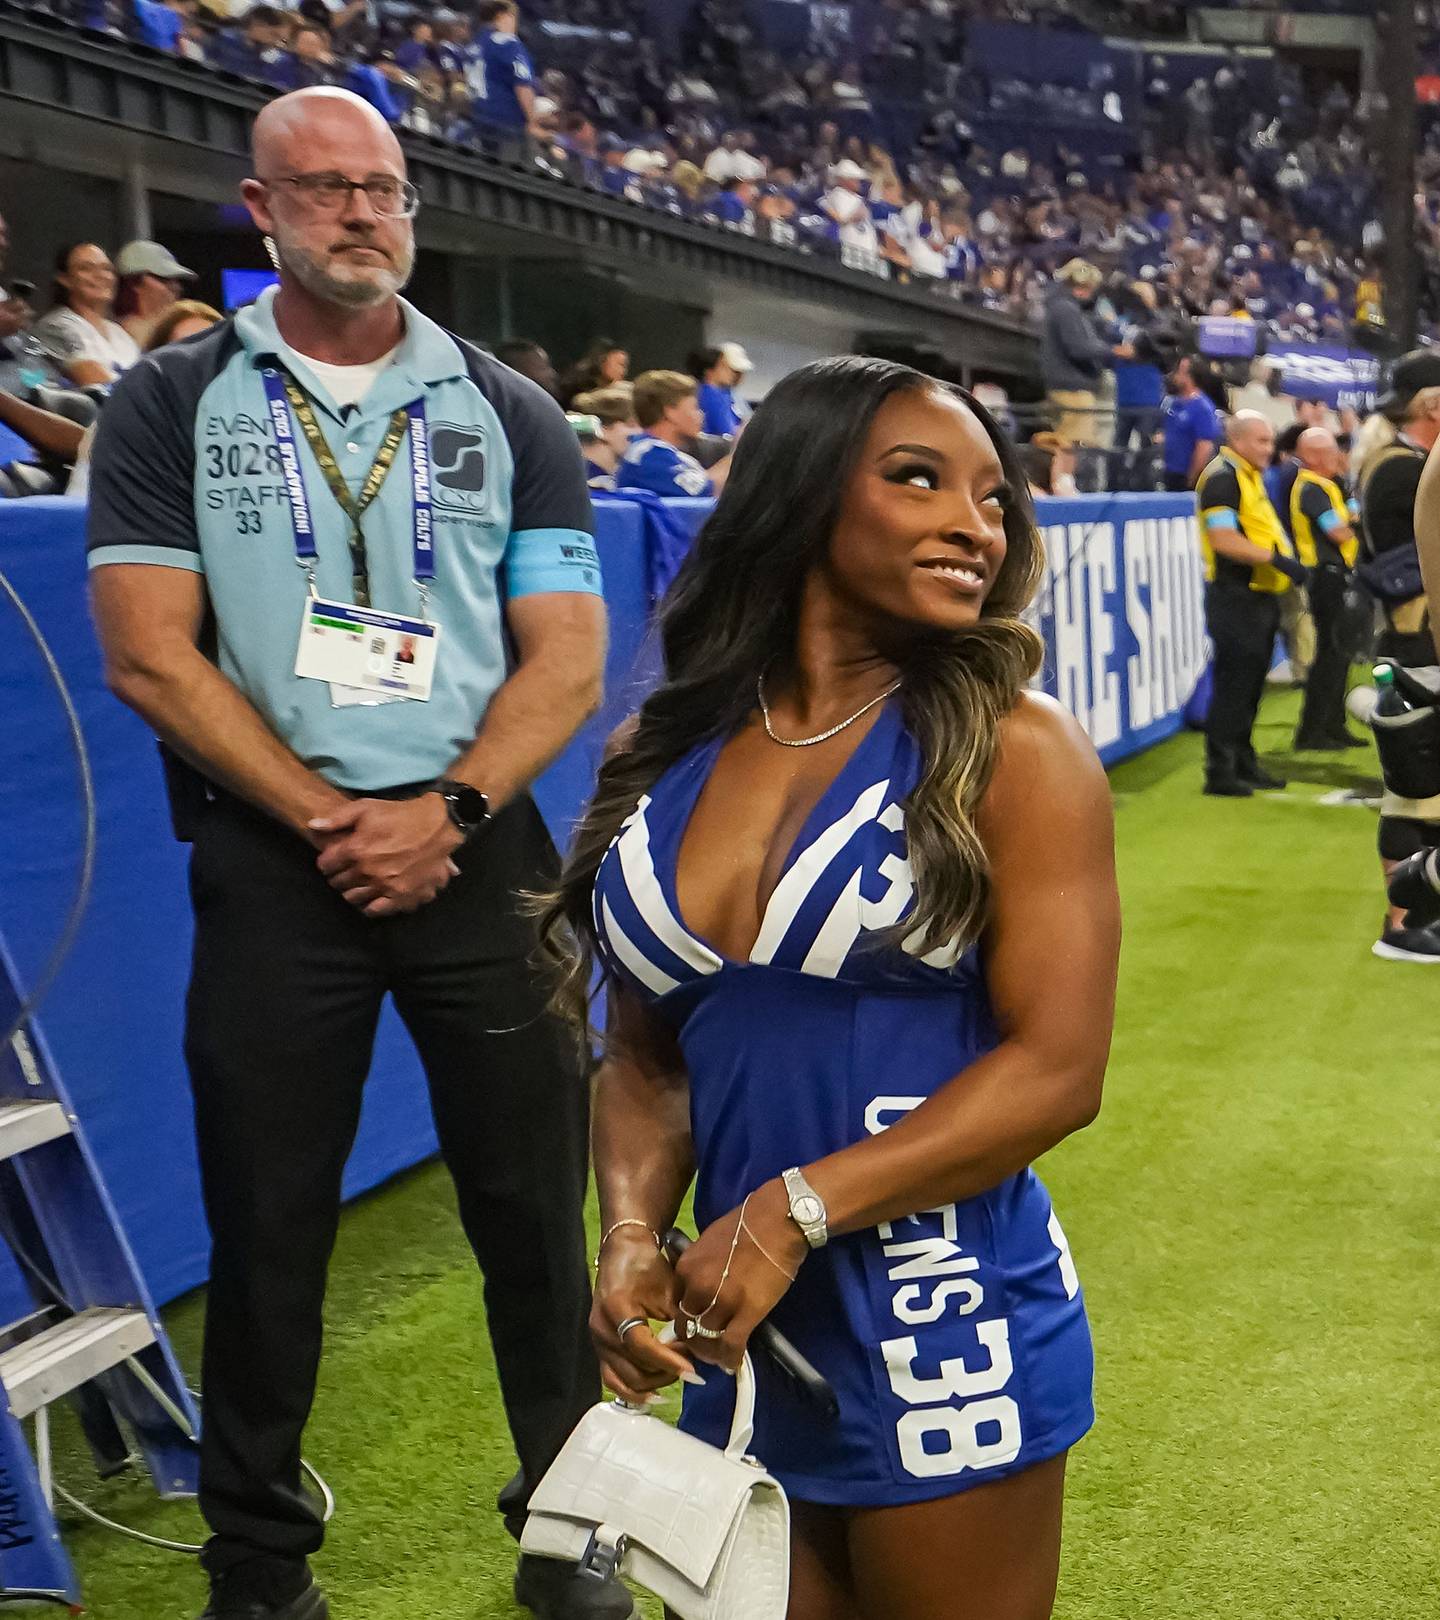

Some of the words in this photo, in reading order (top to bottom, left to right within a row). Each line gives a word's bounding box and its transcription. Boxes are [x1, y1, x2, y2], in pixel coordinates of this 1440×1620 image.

[269, 399, 292, 437] COLTS
[206, 441, 284, 479] 3028
[409, 417, 431, 503] INDIANAPOLIS
[278, 442, 312, 534] INDIANAPOLIS
[235, 510, 262, 534] 33
[415, 508, 432, 551] COLTS
[880, 1317, 1023, 1479] 38
